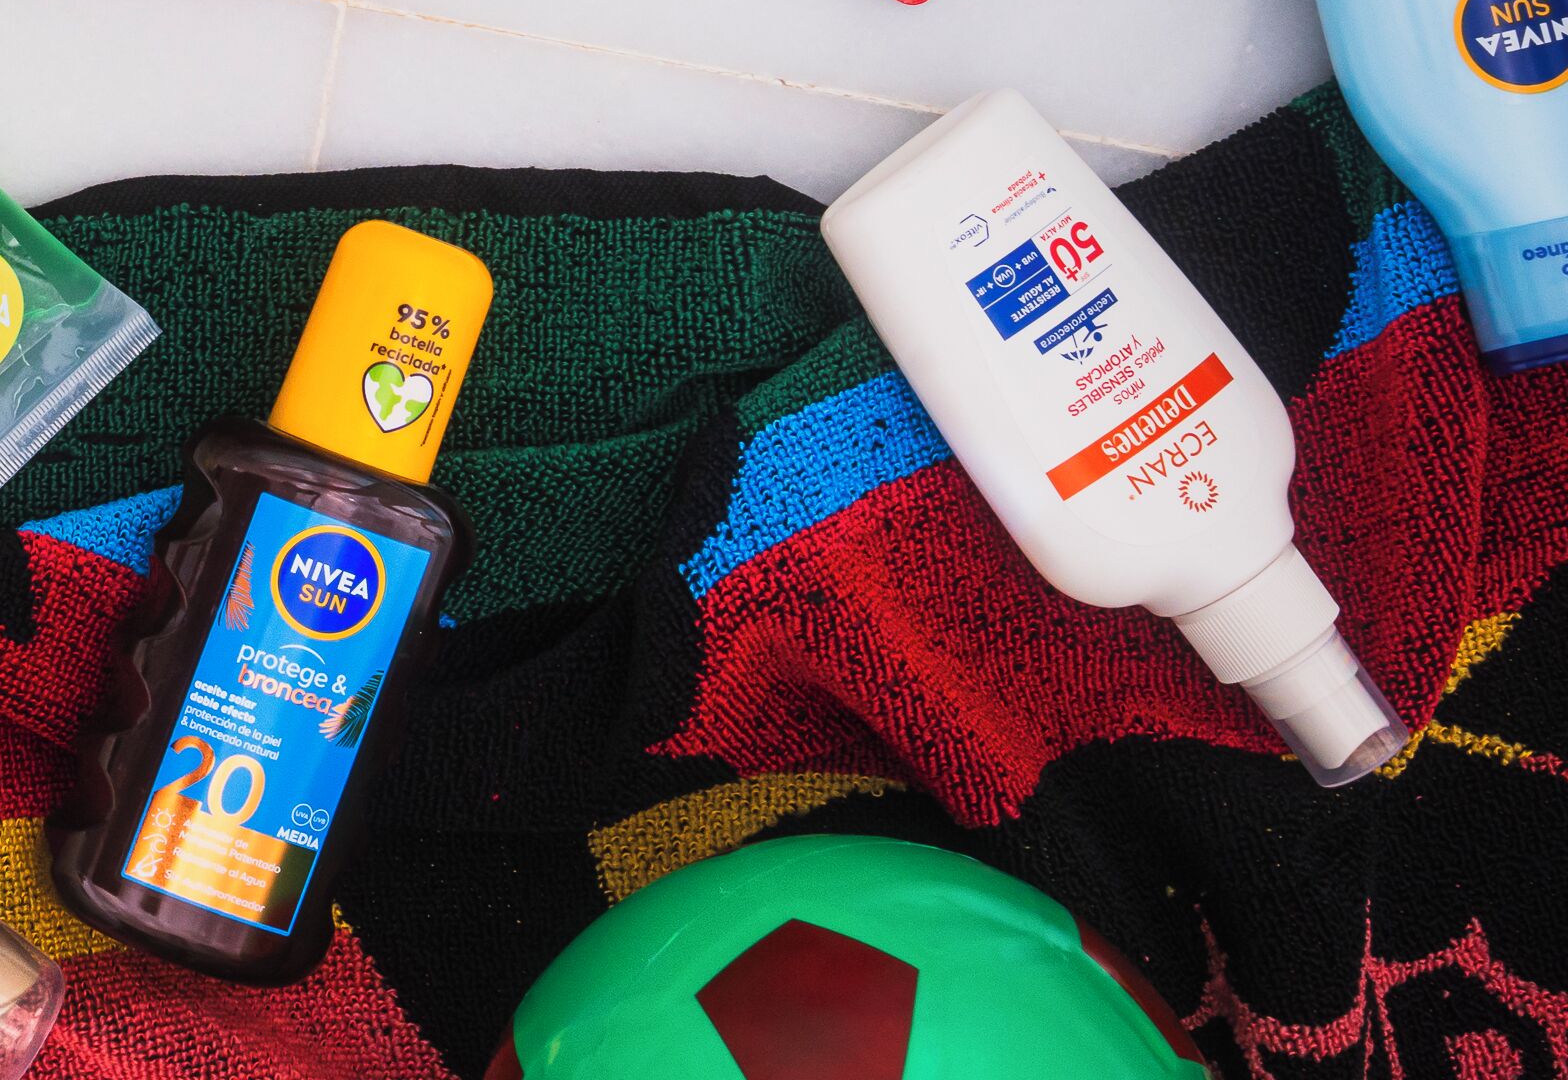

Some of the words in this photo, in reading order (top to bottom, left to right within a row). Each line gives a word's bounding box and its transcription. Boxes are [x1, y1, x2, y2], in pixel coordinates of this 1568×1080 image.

[1018, 283, 1043, 304] AGUA
[1042, 275, 1054, 289] AL
[1011, 284, 1061, 322] RESISTENTE
[1087, 294, 1117, 315] Leche
[389, 326, 443, 357] botella
[1038, 311, 1089, 348] protectora
[1131, 334, 1142, 350] y
[1075, 343, 1133, 391] ATÓPICAS
[1128, 337, 1165, 369] pieles
[1068, 365, 1135, 417] SENSIBLES
[1113, 378, 1146, 405] niños
[1094, 385, 1197, 462] Denenes
[290, 553, 368, 599] NIVEA
[299, 583, 347, 614] SUN
[237, 644, 329, 690] protege
[332, 674, 347, 696] &
[238, 663, 332, 715] broncea
[152, 736, 265, 833] 20
[274, 826, 318, 850] MEDIA
